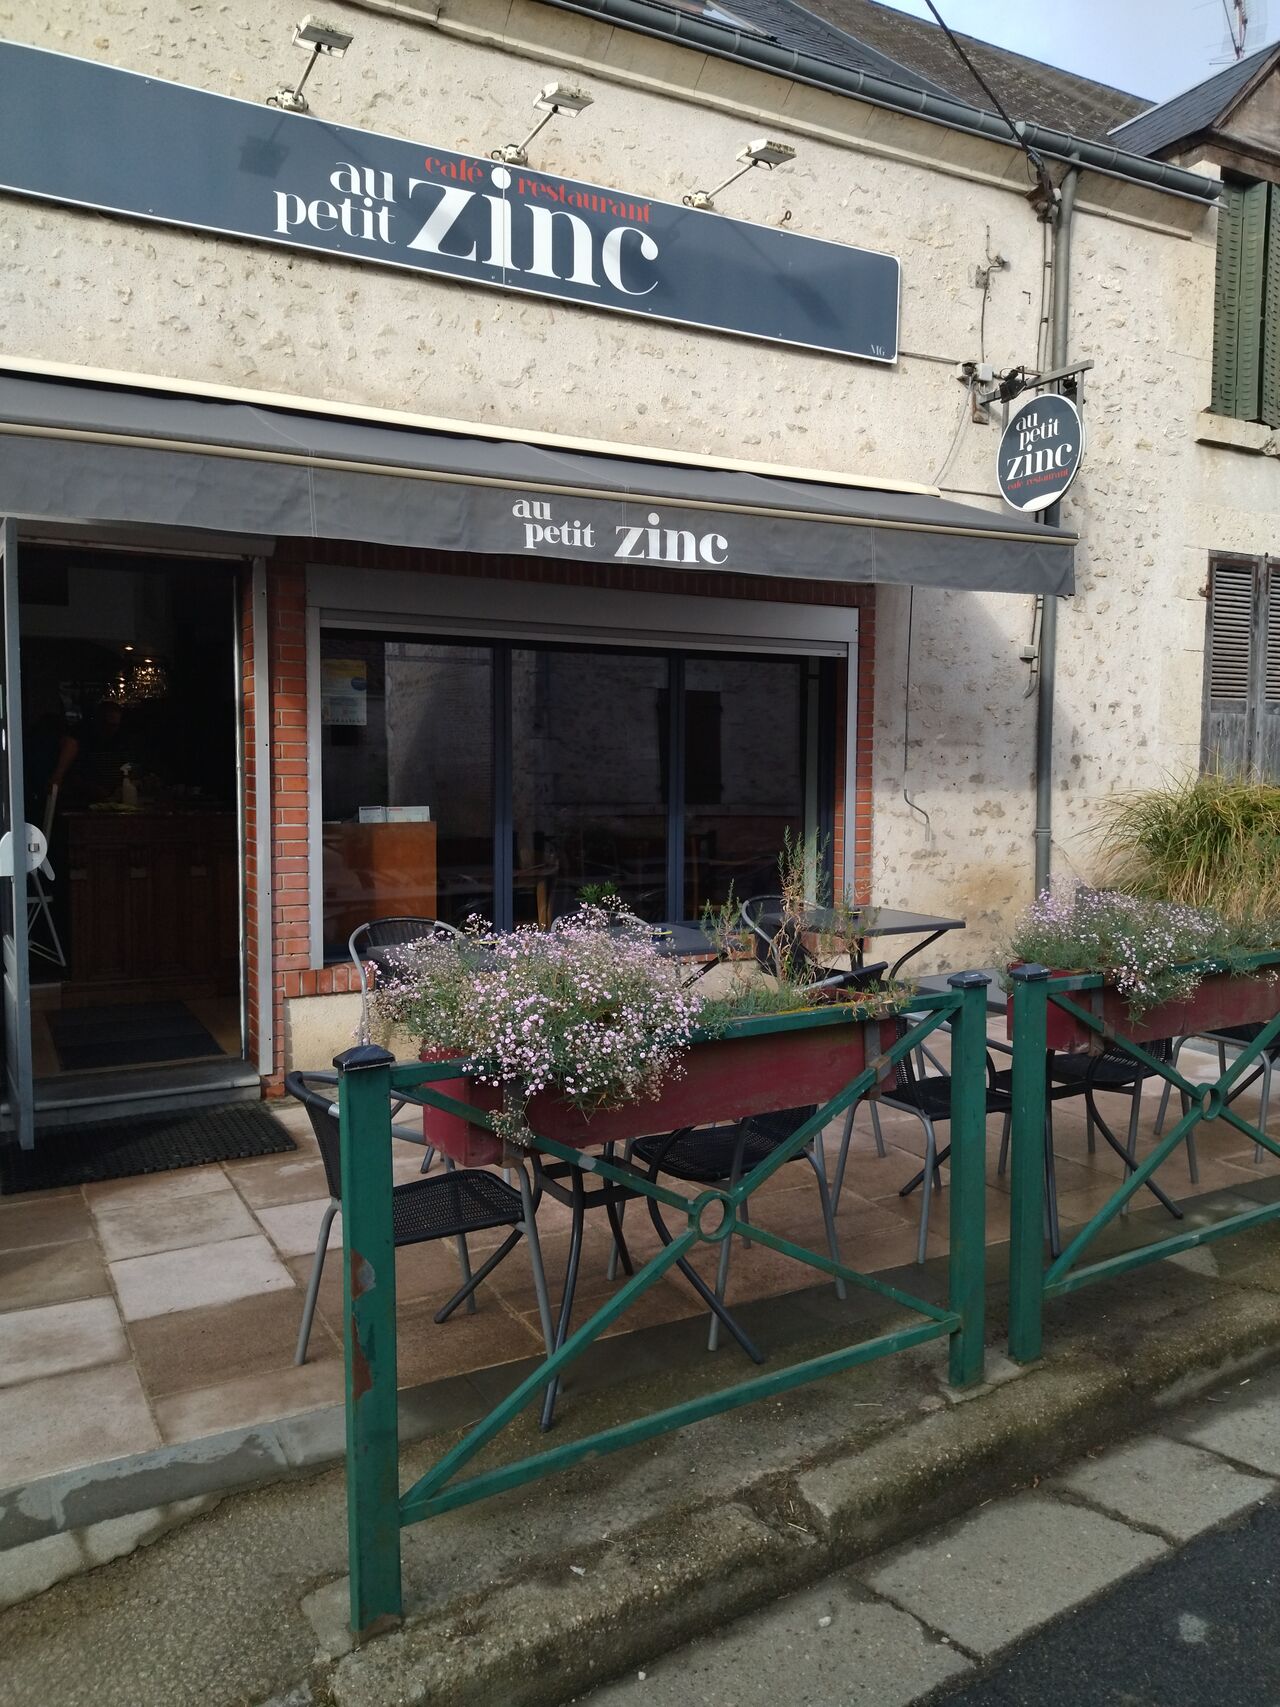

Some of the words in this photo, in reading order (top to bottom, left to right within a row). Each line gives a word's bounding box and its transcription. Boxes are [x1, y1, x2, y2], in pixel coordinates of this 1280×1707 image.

[329, 161, 397, 203] au
[424, 155, 484, 184] café
[517, 176, 652, 224] restaurant
[273, 190, 397, 245] petit
[406, 167, 659, 296] zinc
[1015, 412, 1038, 432] au
[1019, 417, 1060, 451] petit
[1006, 443, 1073, 481] zinc
[511, 498, 552, 521] au
[523, 519, 596, 550] petit
[613, 512, 729, 565] zinc
